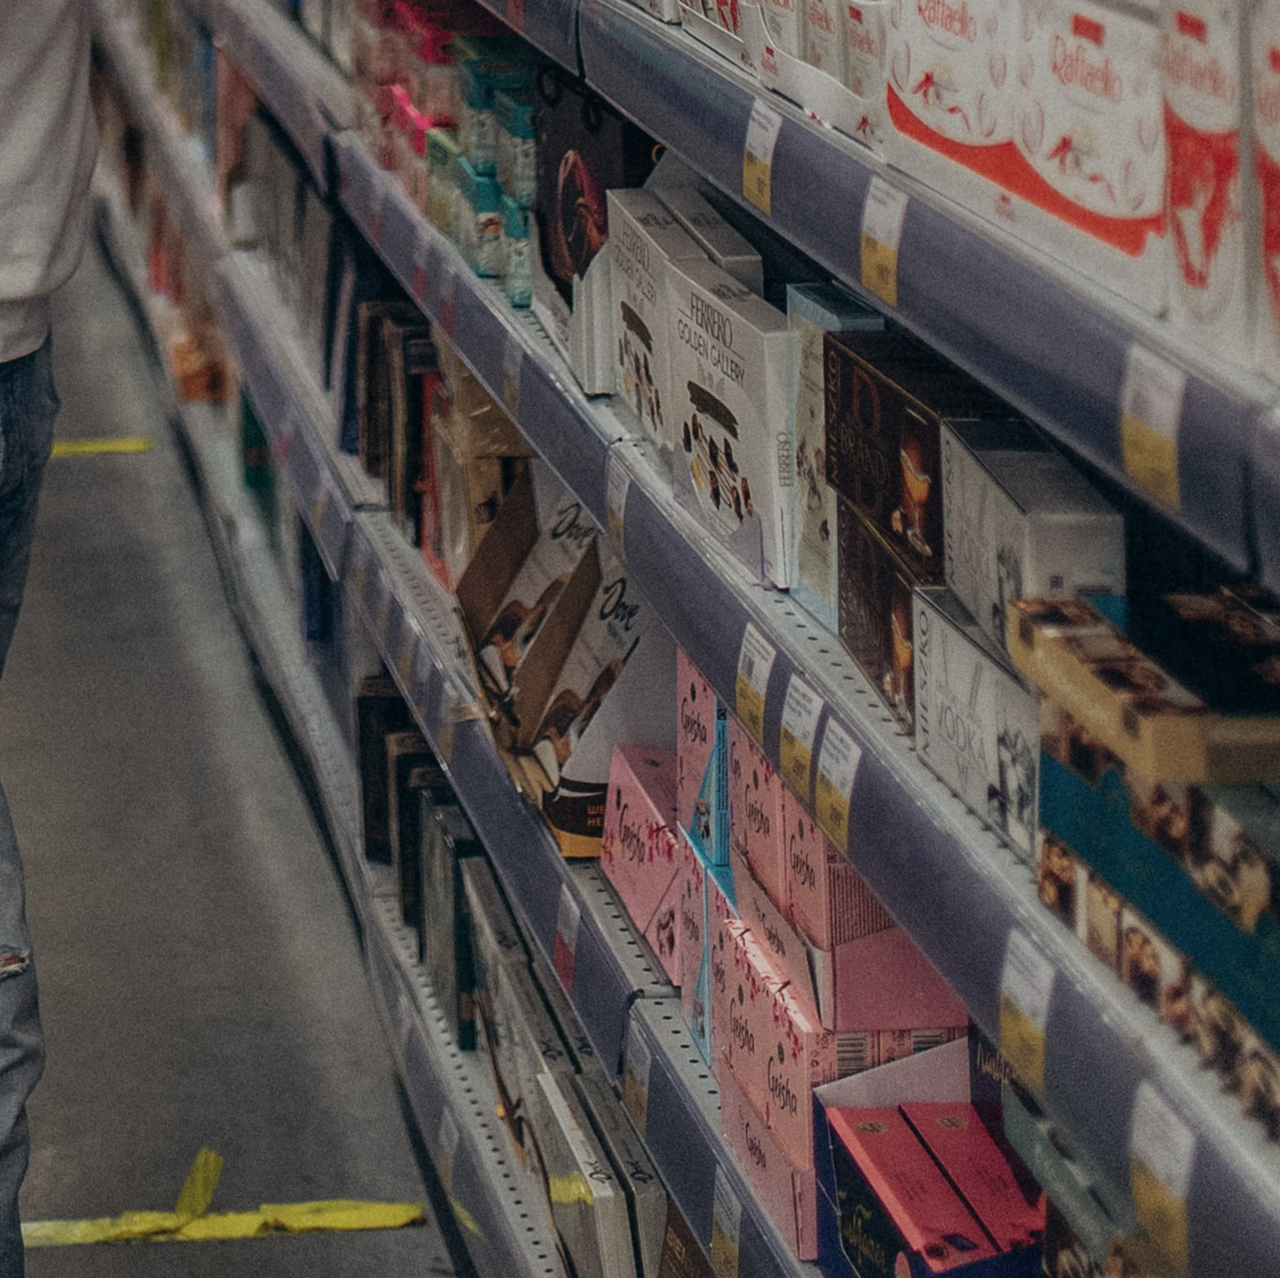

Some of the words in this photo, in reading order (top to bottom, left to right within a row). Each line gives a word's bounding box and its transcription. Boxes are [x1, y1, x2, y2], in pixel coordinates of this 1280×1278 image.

[690, 292, 733, 349] FERRERO
[677, 318, 708, 361] GOLDEN
[709, 344, 746, 388] GALLERY
[776, 431, 794, 488] FERRERO
[551, 502, 597, 542] Dove
[599, 577, 641, 631] Dove
[919, 609, 930, 756] MIESZKO
[682, 696, 707, 744] Geisha
[620, 803, 646, 863] Geisha
[745, 784, 770, 838] Geisha
[789, 833, 816, 892] Geisha
[730, 997, 755, 1056] Geisha
[768, 1055, 798, 1117] Geisha
[745, 1121, 767, 1169] Geisha
